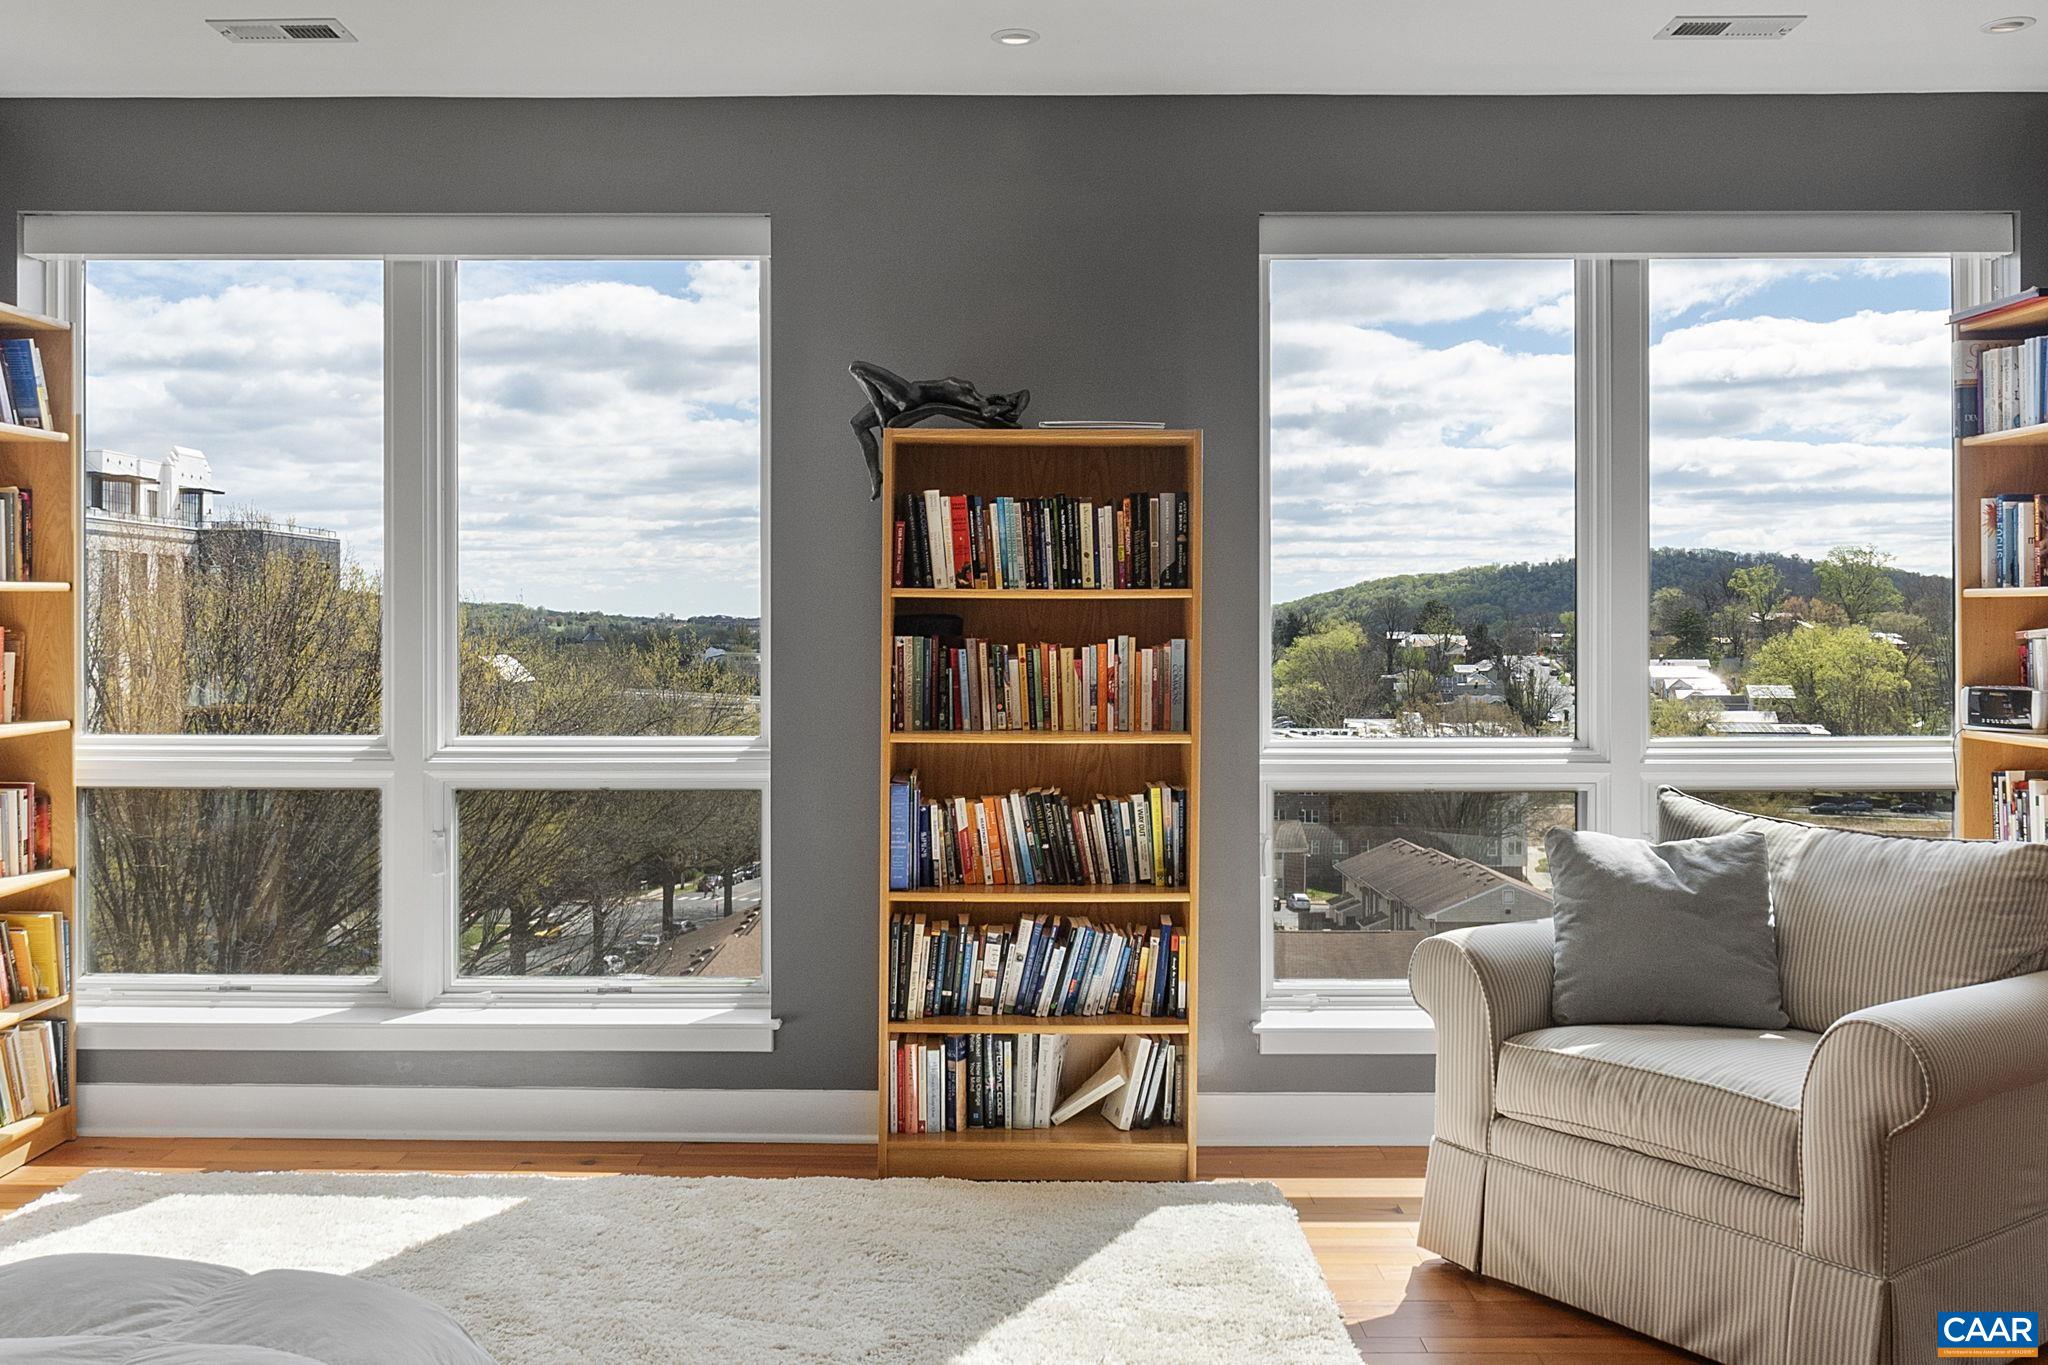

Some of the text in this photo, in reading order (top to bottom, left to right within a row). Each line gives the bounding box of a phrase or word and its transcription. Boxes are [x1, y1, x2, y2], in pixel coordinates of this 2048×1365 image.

[1137, 808, 1145, 823] WAY
[1038, 820, 1046, 839] HEART
[974, 1083, 982, 1106] Change
